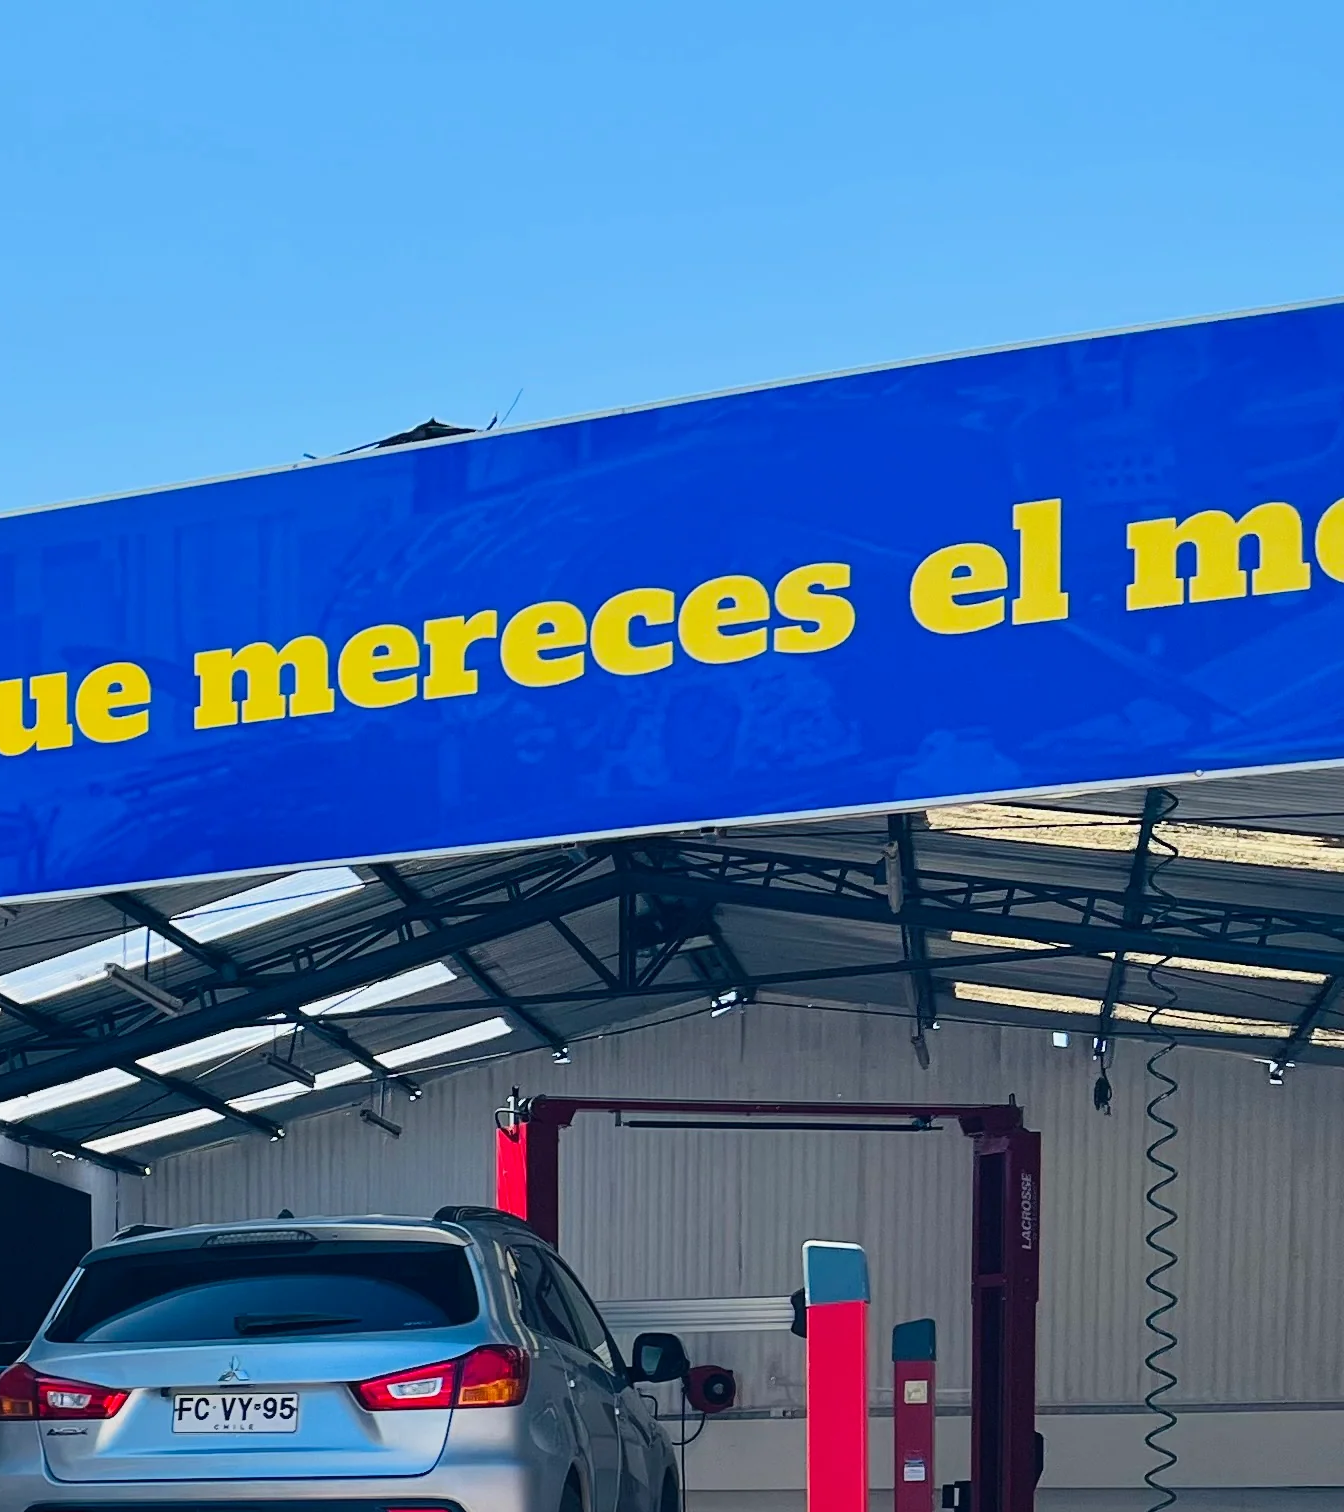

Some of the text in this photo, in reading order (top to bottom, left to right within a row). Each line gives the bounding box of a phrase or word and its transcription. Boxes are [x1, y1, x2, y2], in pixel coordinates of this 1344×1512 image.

[194, 562, 856, 731] mereces
[911, 497, 1070, 635] el
[1021, 1172, 1032, 1249] LACROSSE
